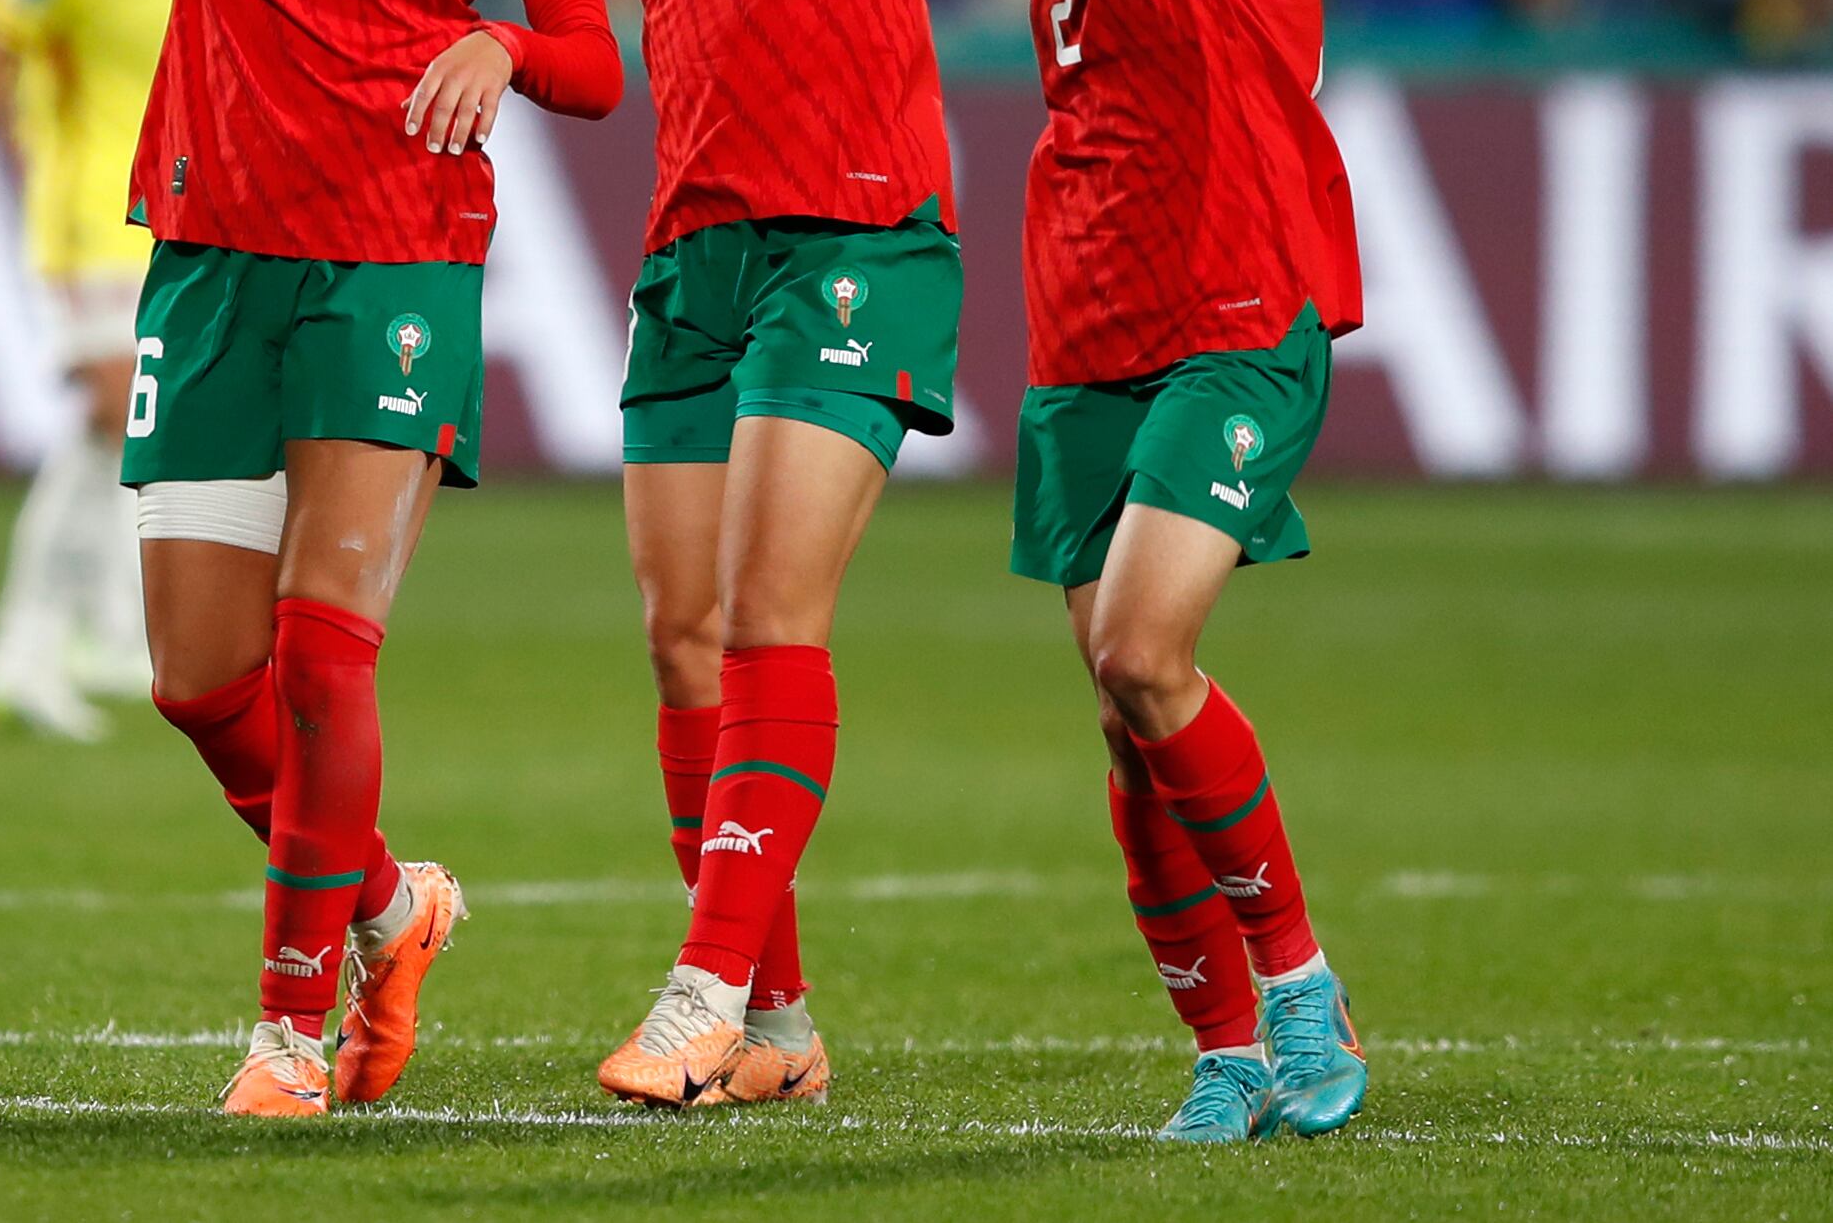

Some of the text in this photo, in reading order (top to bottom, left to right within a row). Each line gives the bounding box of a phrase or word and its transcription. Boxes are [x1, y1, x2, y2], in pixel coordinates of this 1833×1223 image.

[819, 347, 862, 367] PUMA
[377, 395, 418, 416] PUMA
[1210, 481, 1245, 511] PUMA
